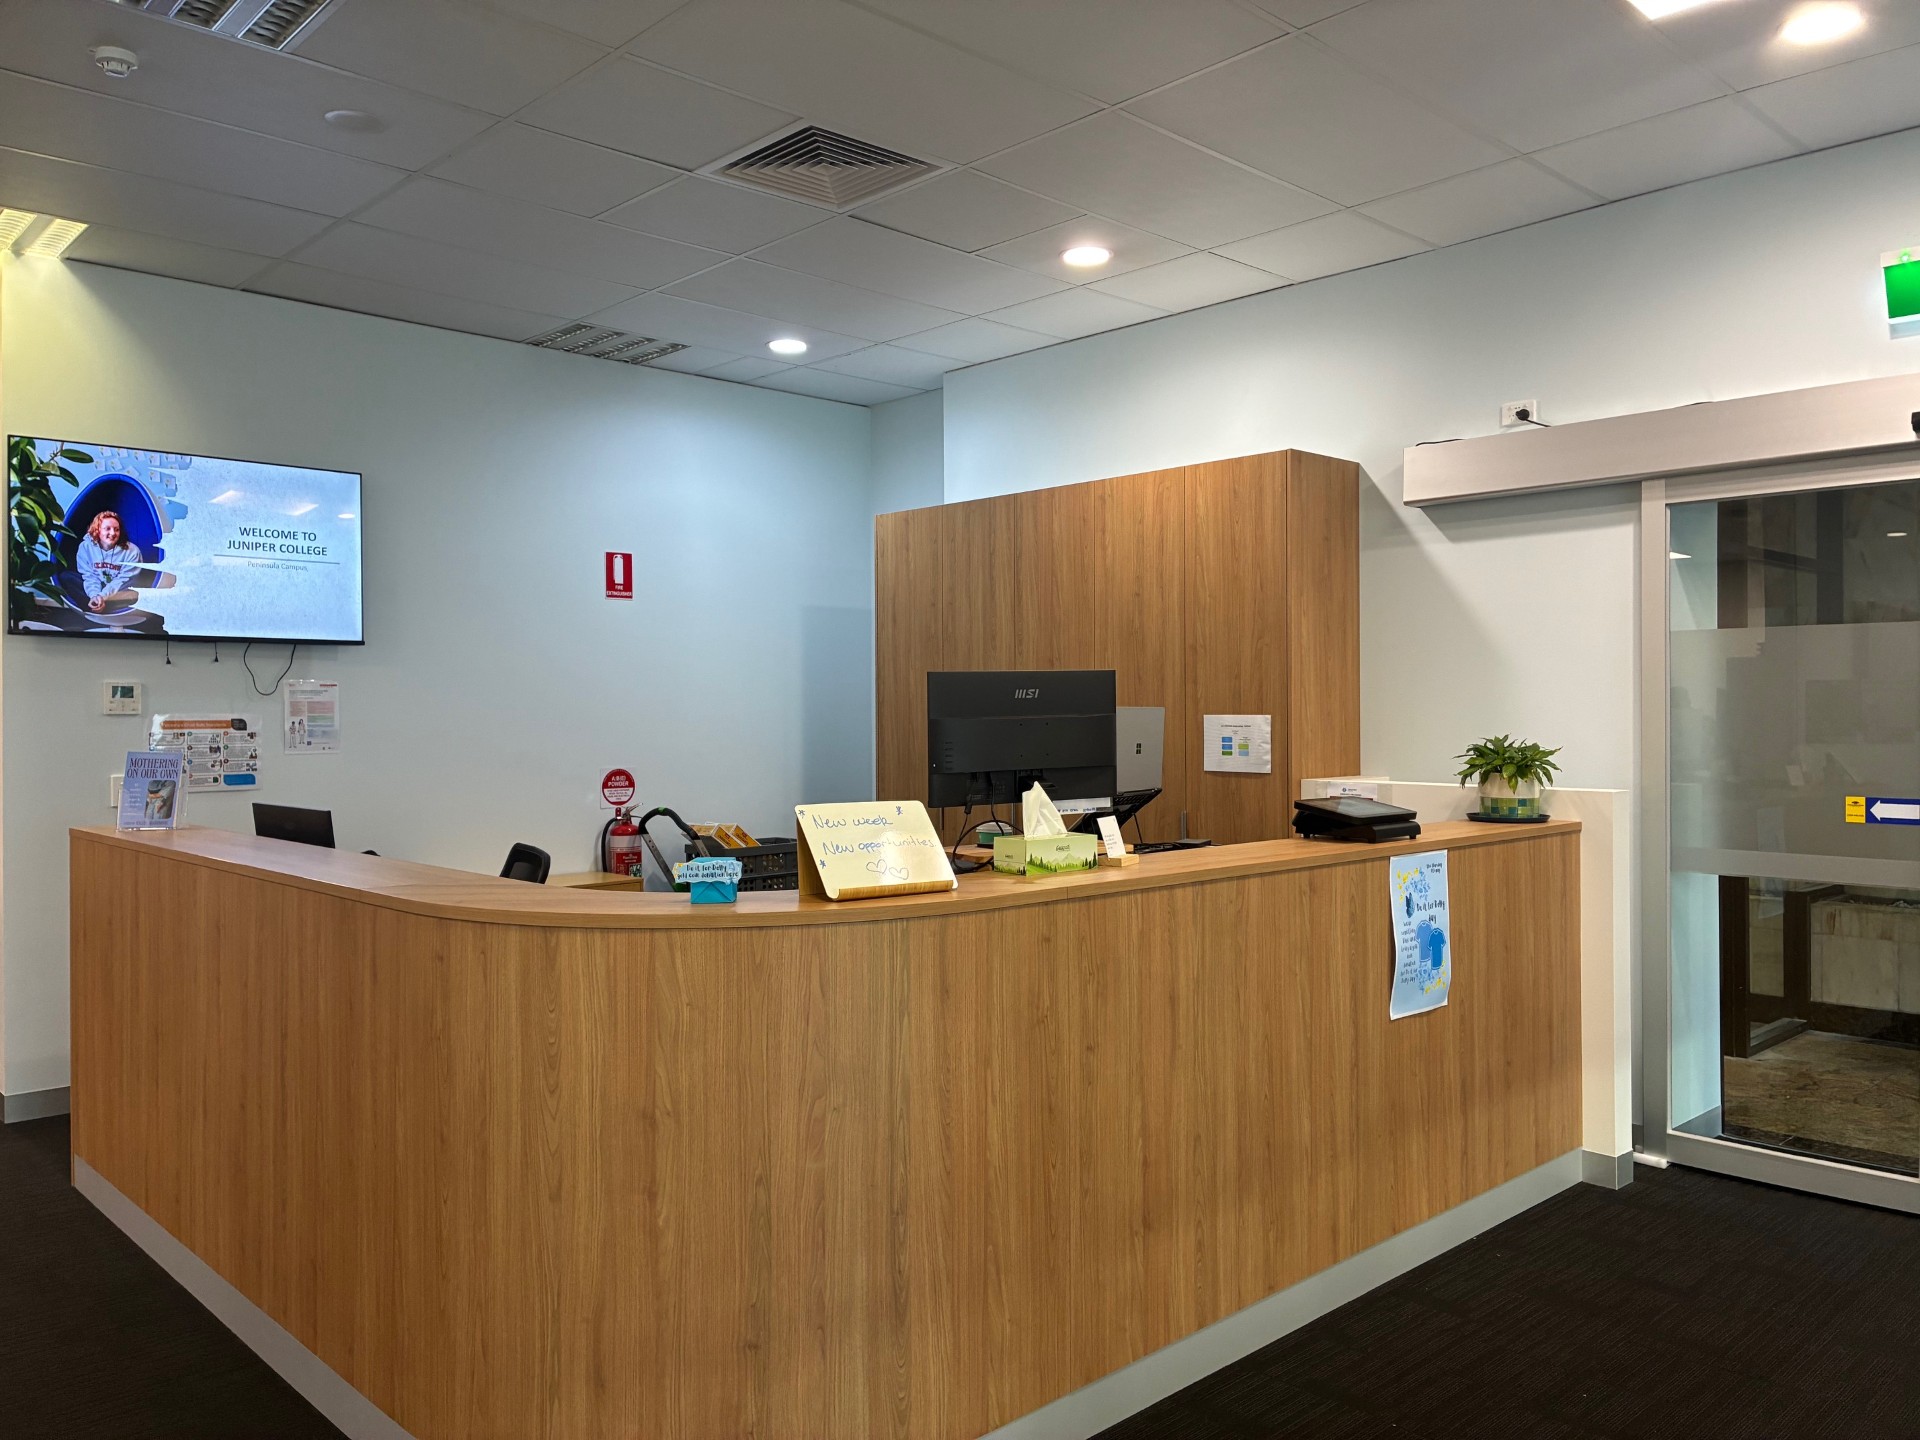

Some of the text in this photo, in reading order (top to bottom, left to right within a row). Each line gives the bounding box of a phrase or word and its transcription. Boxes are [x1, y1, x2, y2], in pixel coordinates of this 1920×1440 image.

[239, 526, 317, 542] WELCOME TO
[227, 540, 328, 557] JUNIPER COLLEGE
[247, 560, 280, 570] Peninsula
[129, 757, 179, 769] MOTHERING
[126, 768, 179, 779] ON OUR OWN
[811, 814, 894, 829] New week
[822, 841, 855, 856] New
